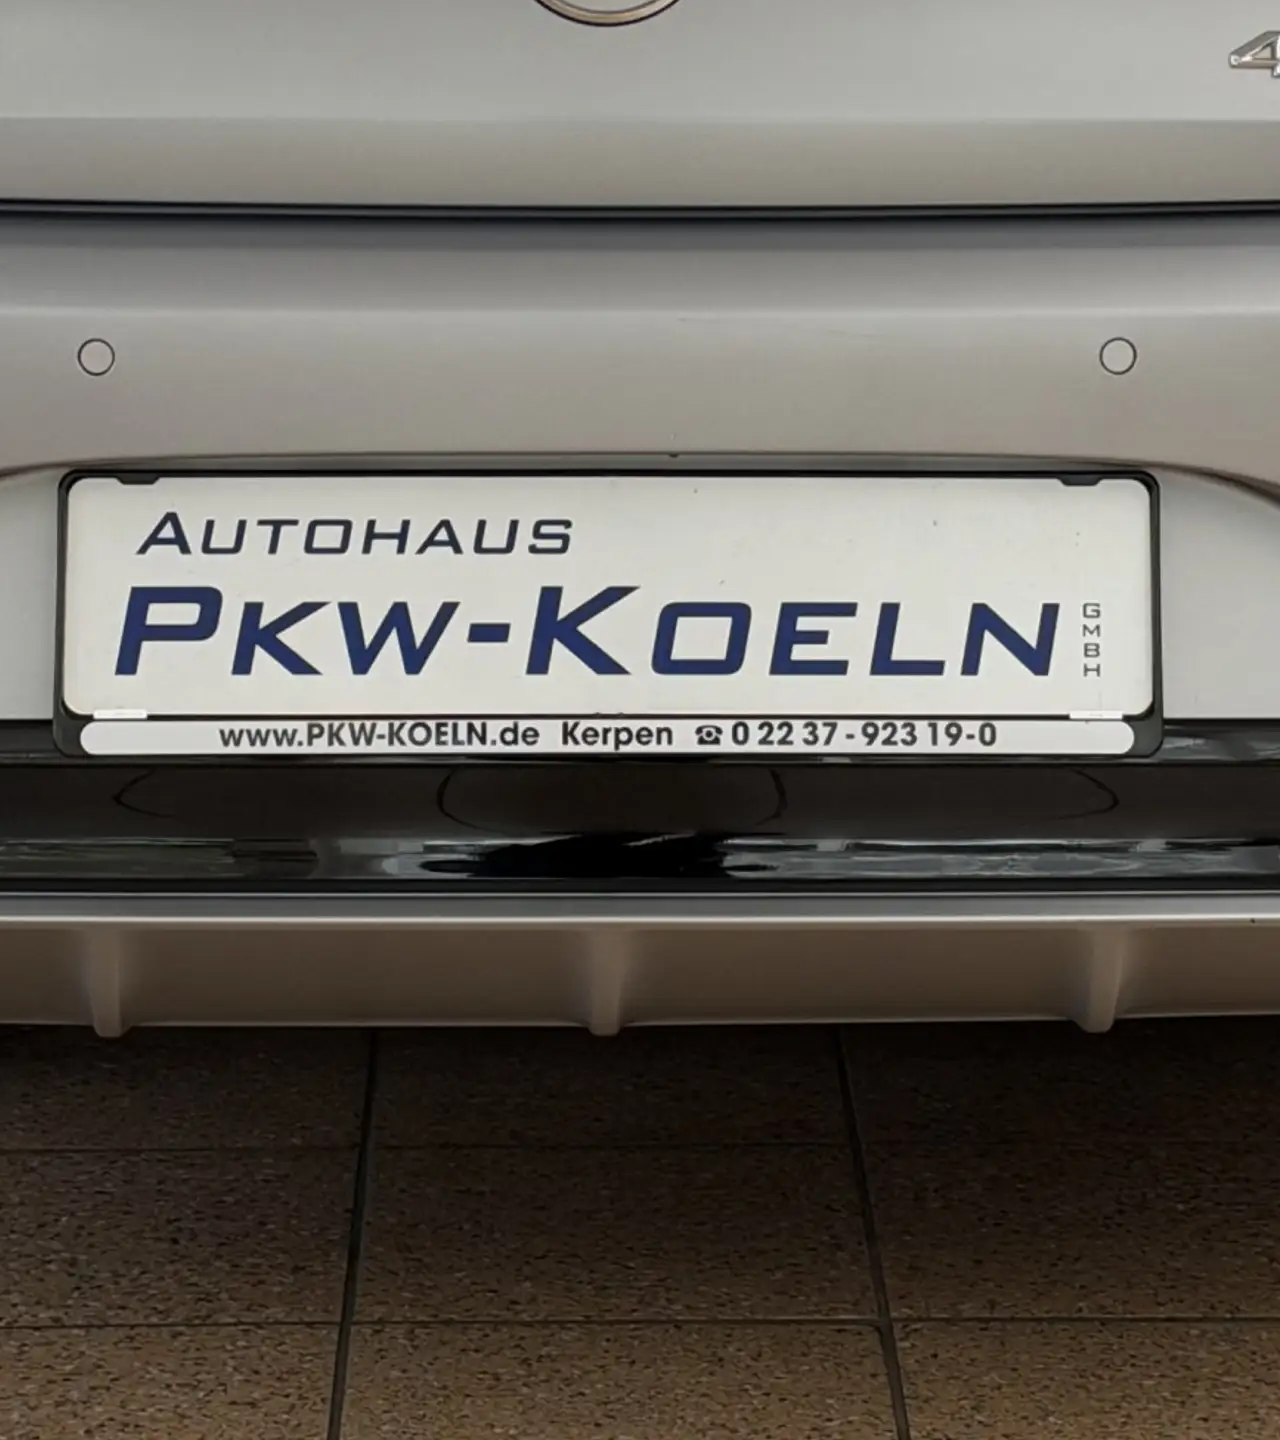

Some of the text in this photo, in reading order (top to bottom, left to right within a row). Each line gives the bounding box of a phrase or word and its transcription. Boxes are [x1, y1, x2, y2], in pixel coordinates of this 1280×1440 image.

[136, 511, 574, 555] AUTOHAUS
[114, 585, 1060, 677] PKW-KOELN
[1082, 602, 1102, 678] GMBH
[219, 721, 540, 748] www.PKW-KOELN.de
[561, 721, 674, 753] Kerpen
